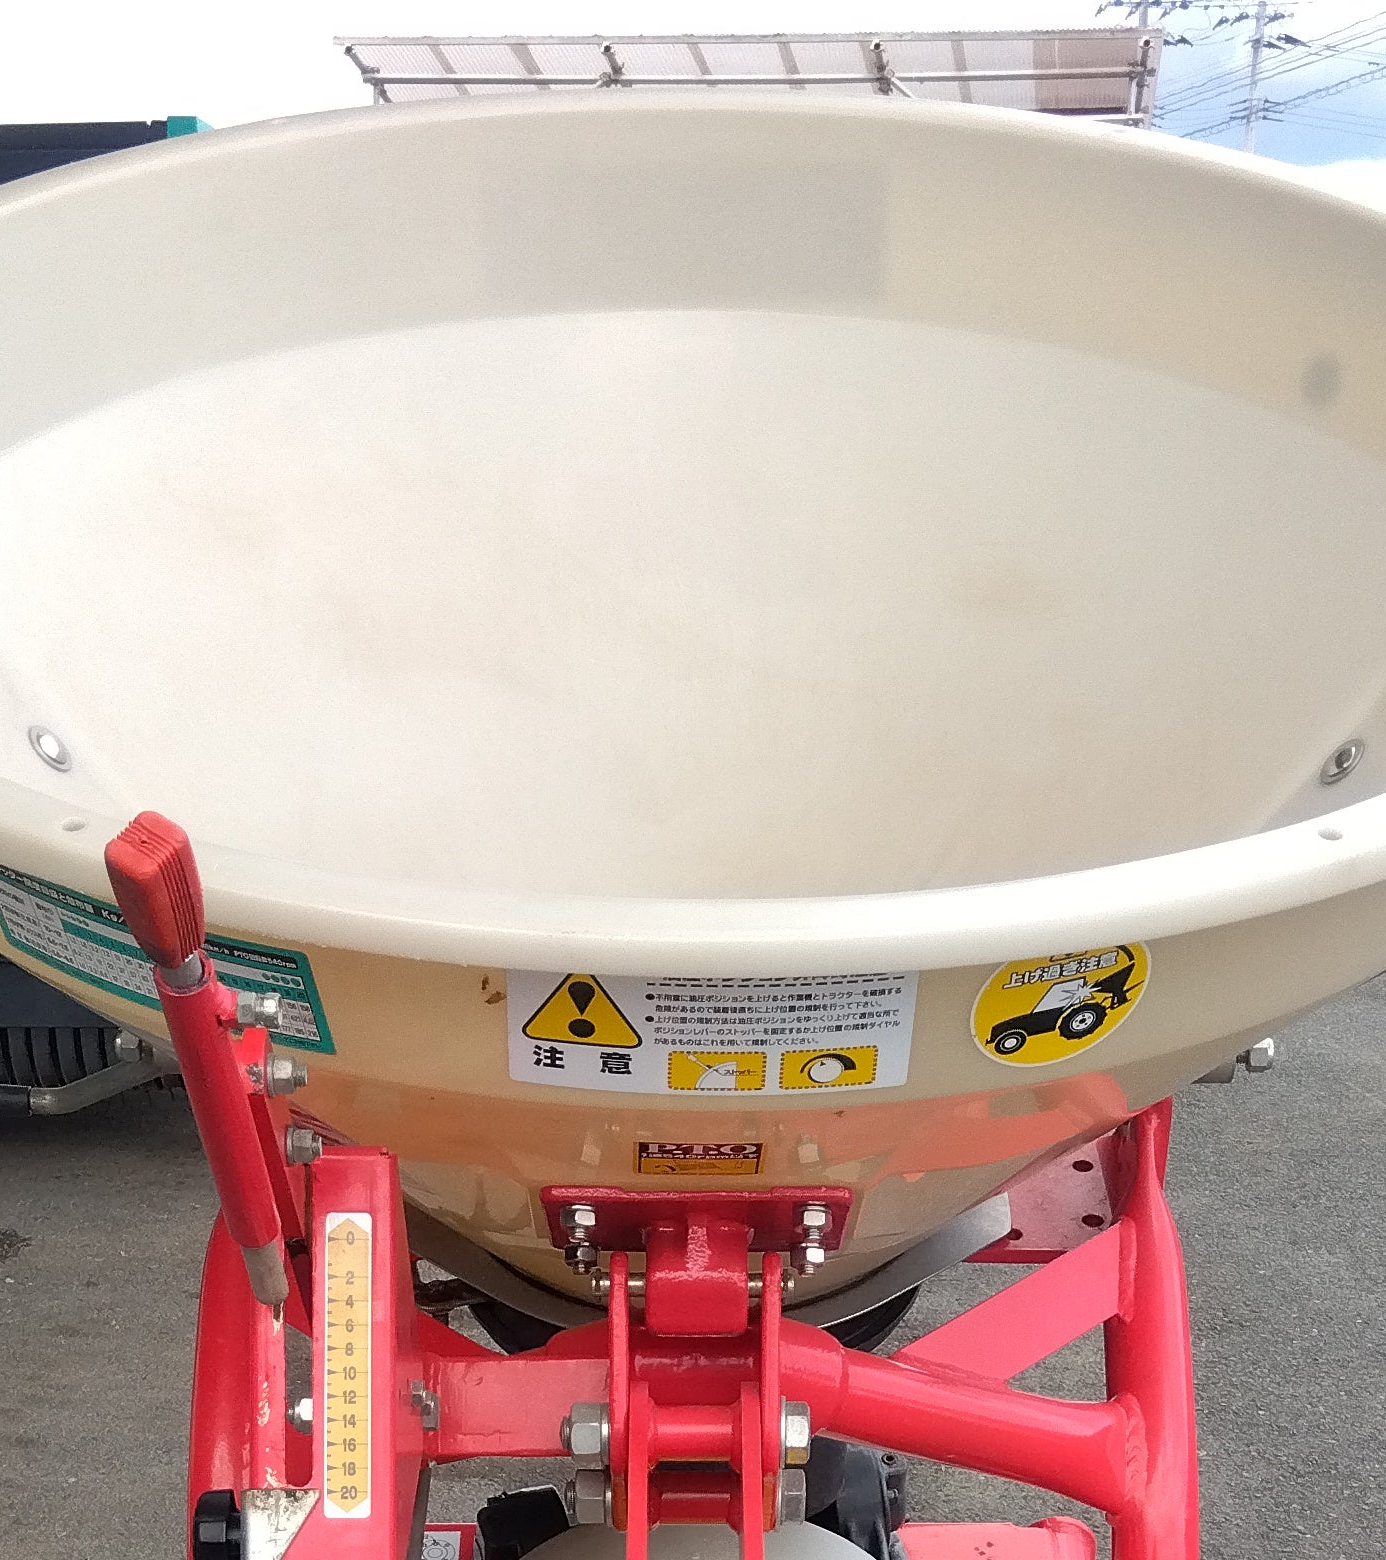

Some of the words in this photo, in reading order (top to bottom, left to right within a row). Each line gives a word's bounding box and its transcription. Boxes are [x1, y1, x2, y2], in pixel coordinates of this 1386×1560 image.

[1003, 951, 1119, 989] 上げ過ぎ注意
[532, 1044, 633, 1075] 注意
[346, 1231, 355, 1245] 0
[345, 1271, 355, 1285] 2
[345, 1295, 355, 1309] 4
[345, 1318, 354, 1333] 6
[345, 1342, 354, 1356] 8
[342, 1366, 357, 1380] 10
[342, 1390, 357, 1404] 12
[342, 1414, 357, 1428] 14
[342, 1438, 357, 1452] 16
[341, 1462, 356, 1476] 18
[340, 1486, 357, 1500] 20
